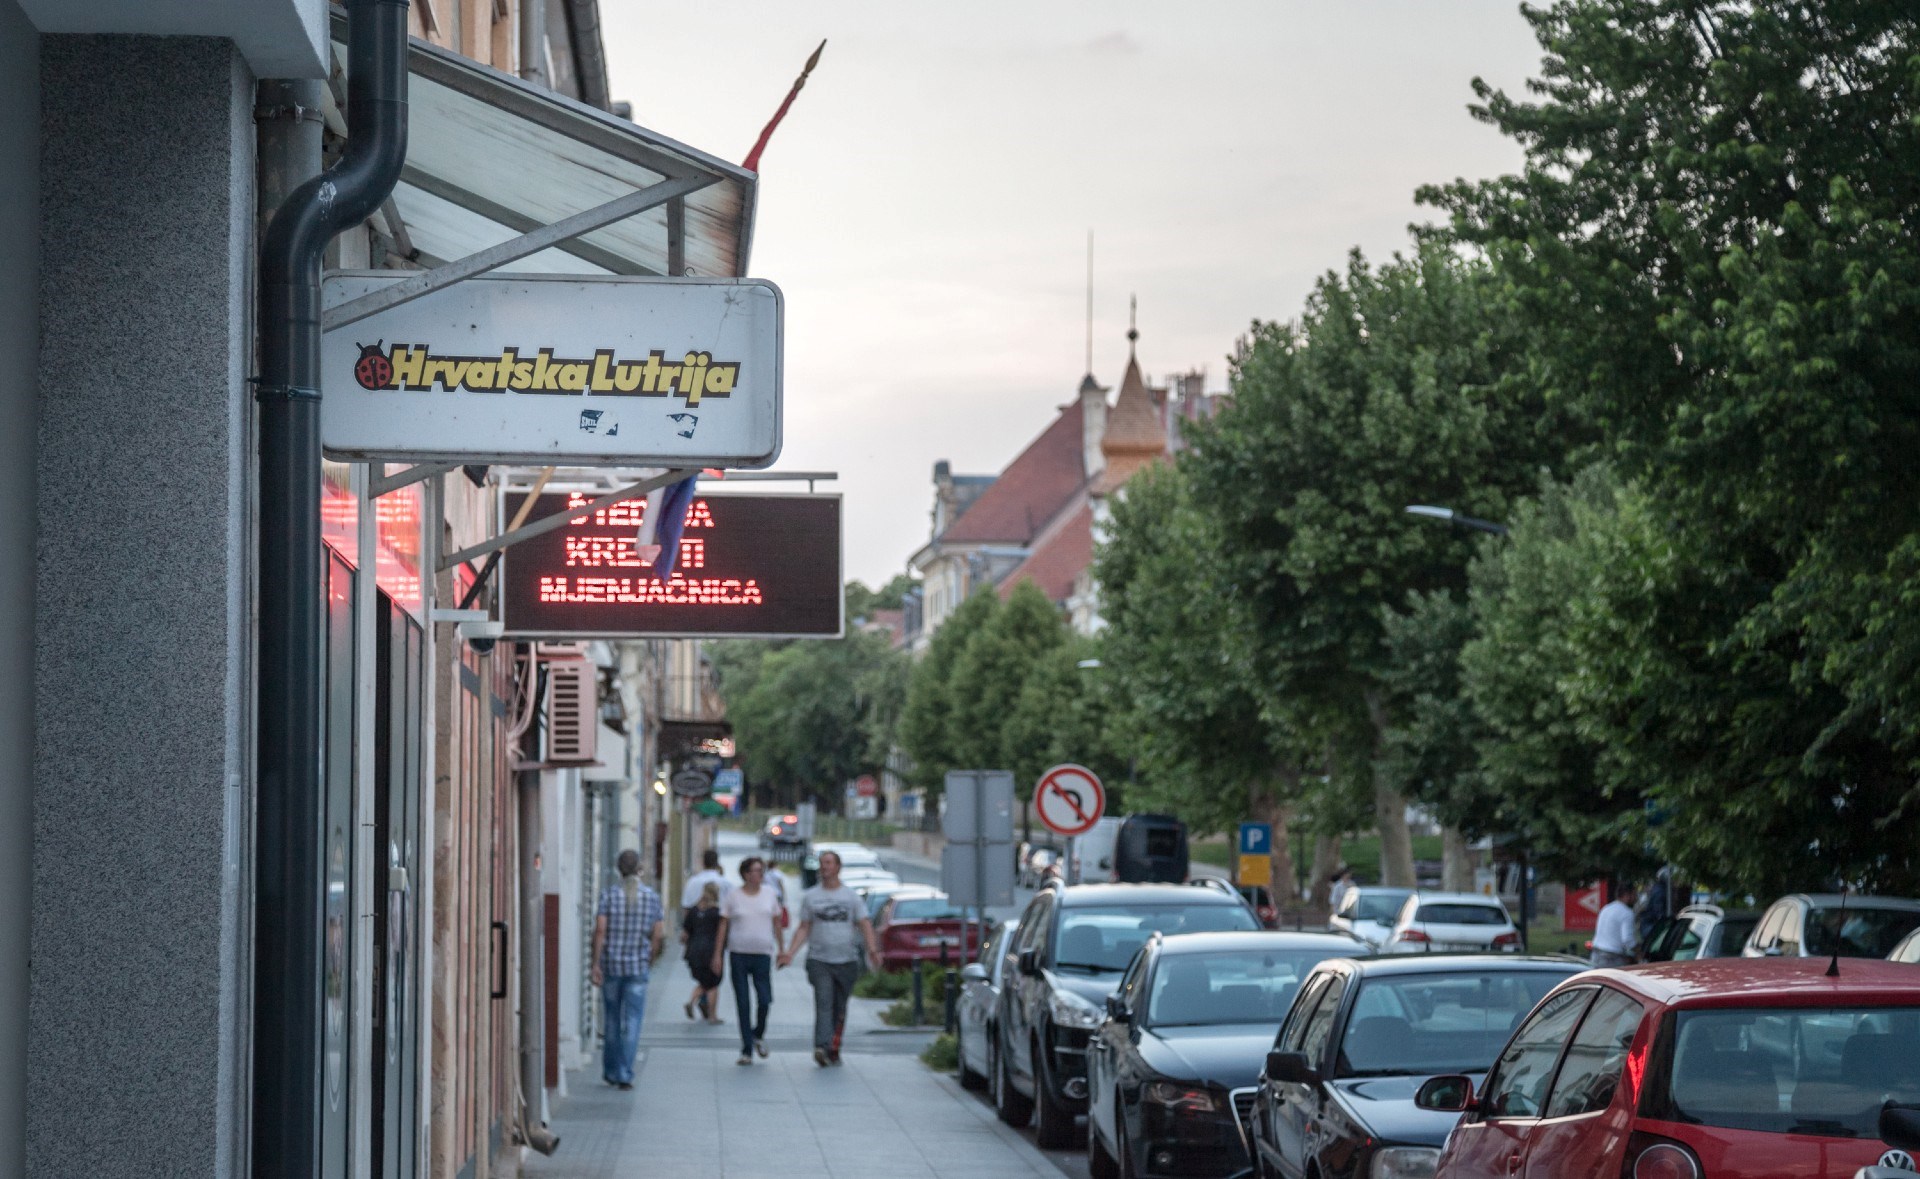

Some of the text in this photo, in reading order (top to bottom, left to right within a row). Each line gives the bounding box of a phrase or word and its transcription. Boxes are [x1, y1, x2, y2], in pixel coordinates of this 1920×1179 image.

[390, 344, 741, 408] Hrvatska Lutrija
[565, 536, 705, 568] KRETI
[540, 572, 763, 605] MJENJAČNICA
[1248, 827, 1264, 850] P
